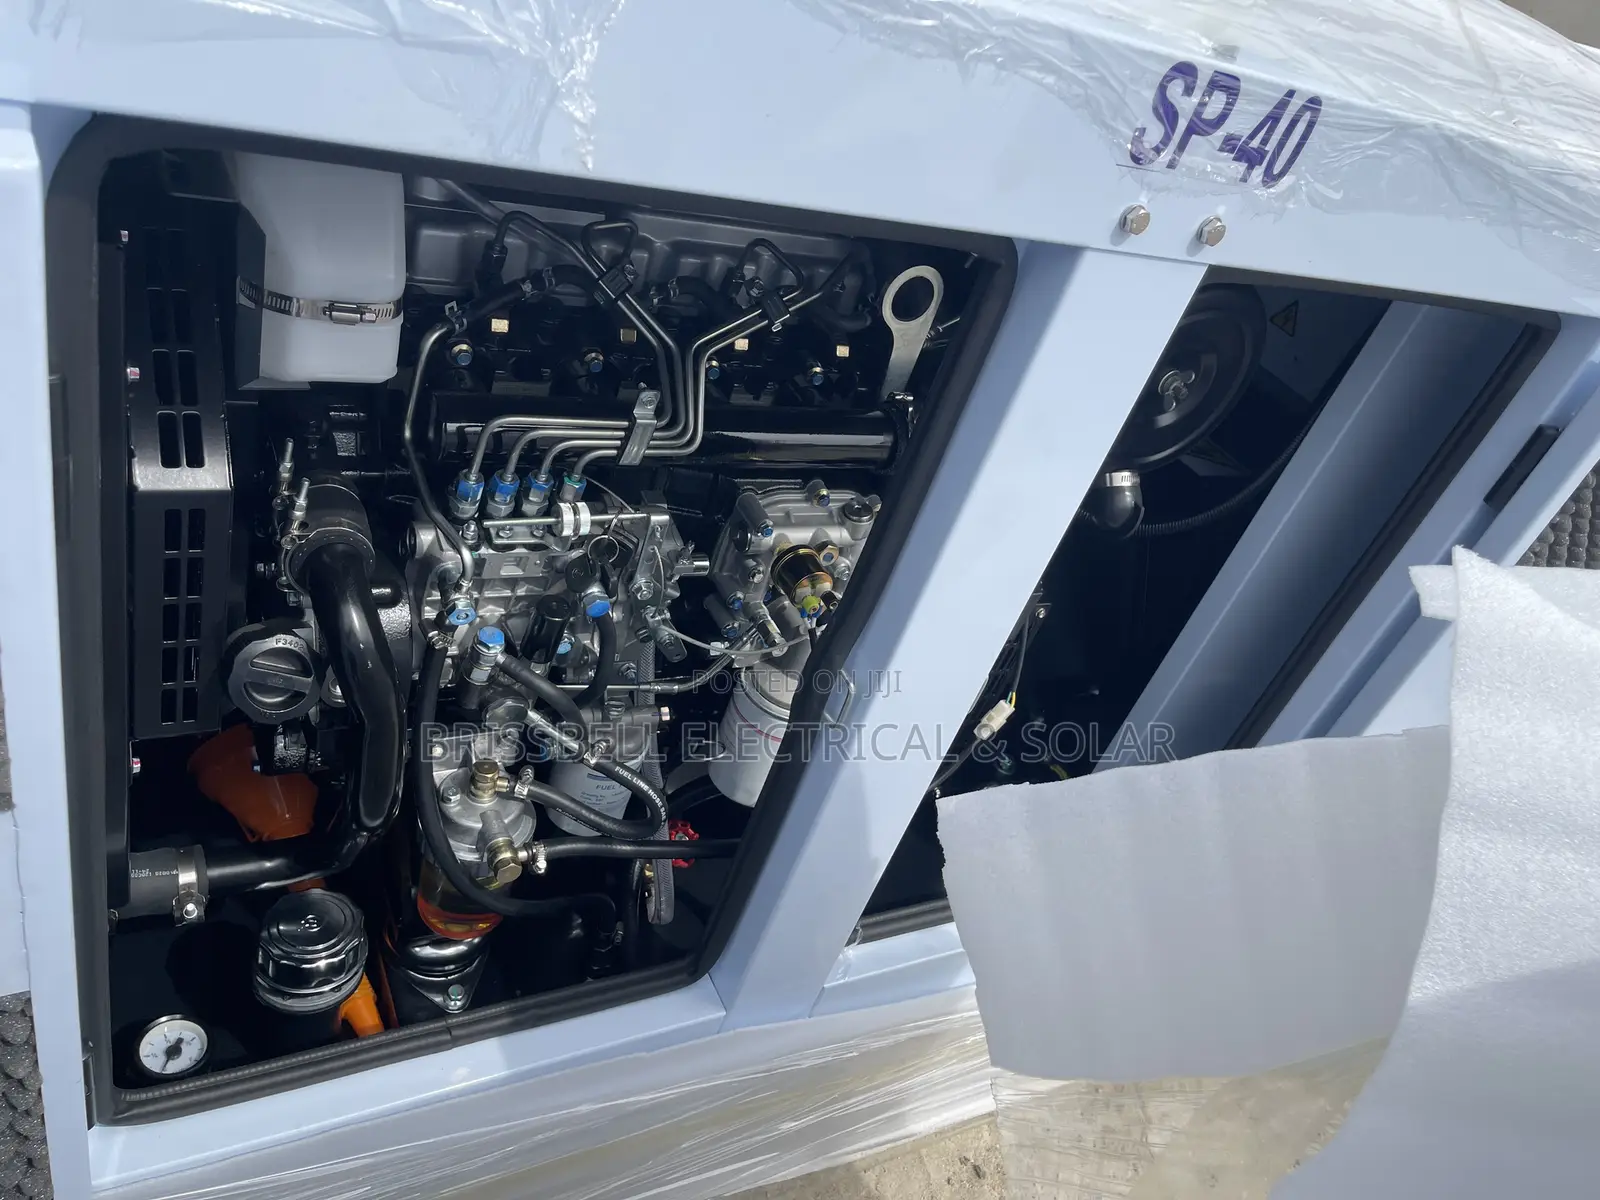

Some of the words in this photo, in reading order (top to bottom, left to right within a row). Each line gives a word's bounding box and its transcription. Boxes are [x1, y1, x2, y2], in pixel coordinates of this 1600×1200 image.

[1129, 60, 1323, 189] SP-40
[614, 765, 632, 781] FUEL
[632, 777, 649, 791] LINE
[648, 788, 663, 808] HOSE
